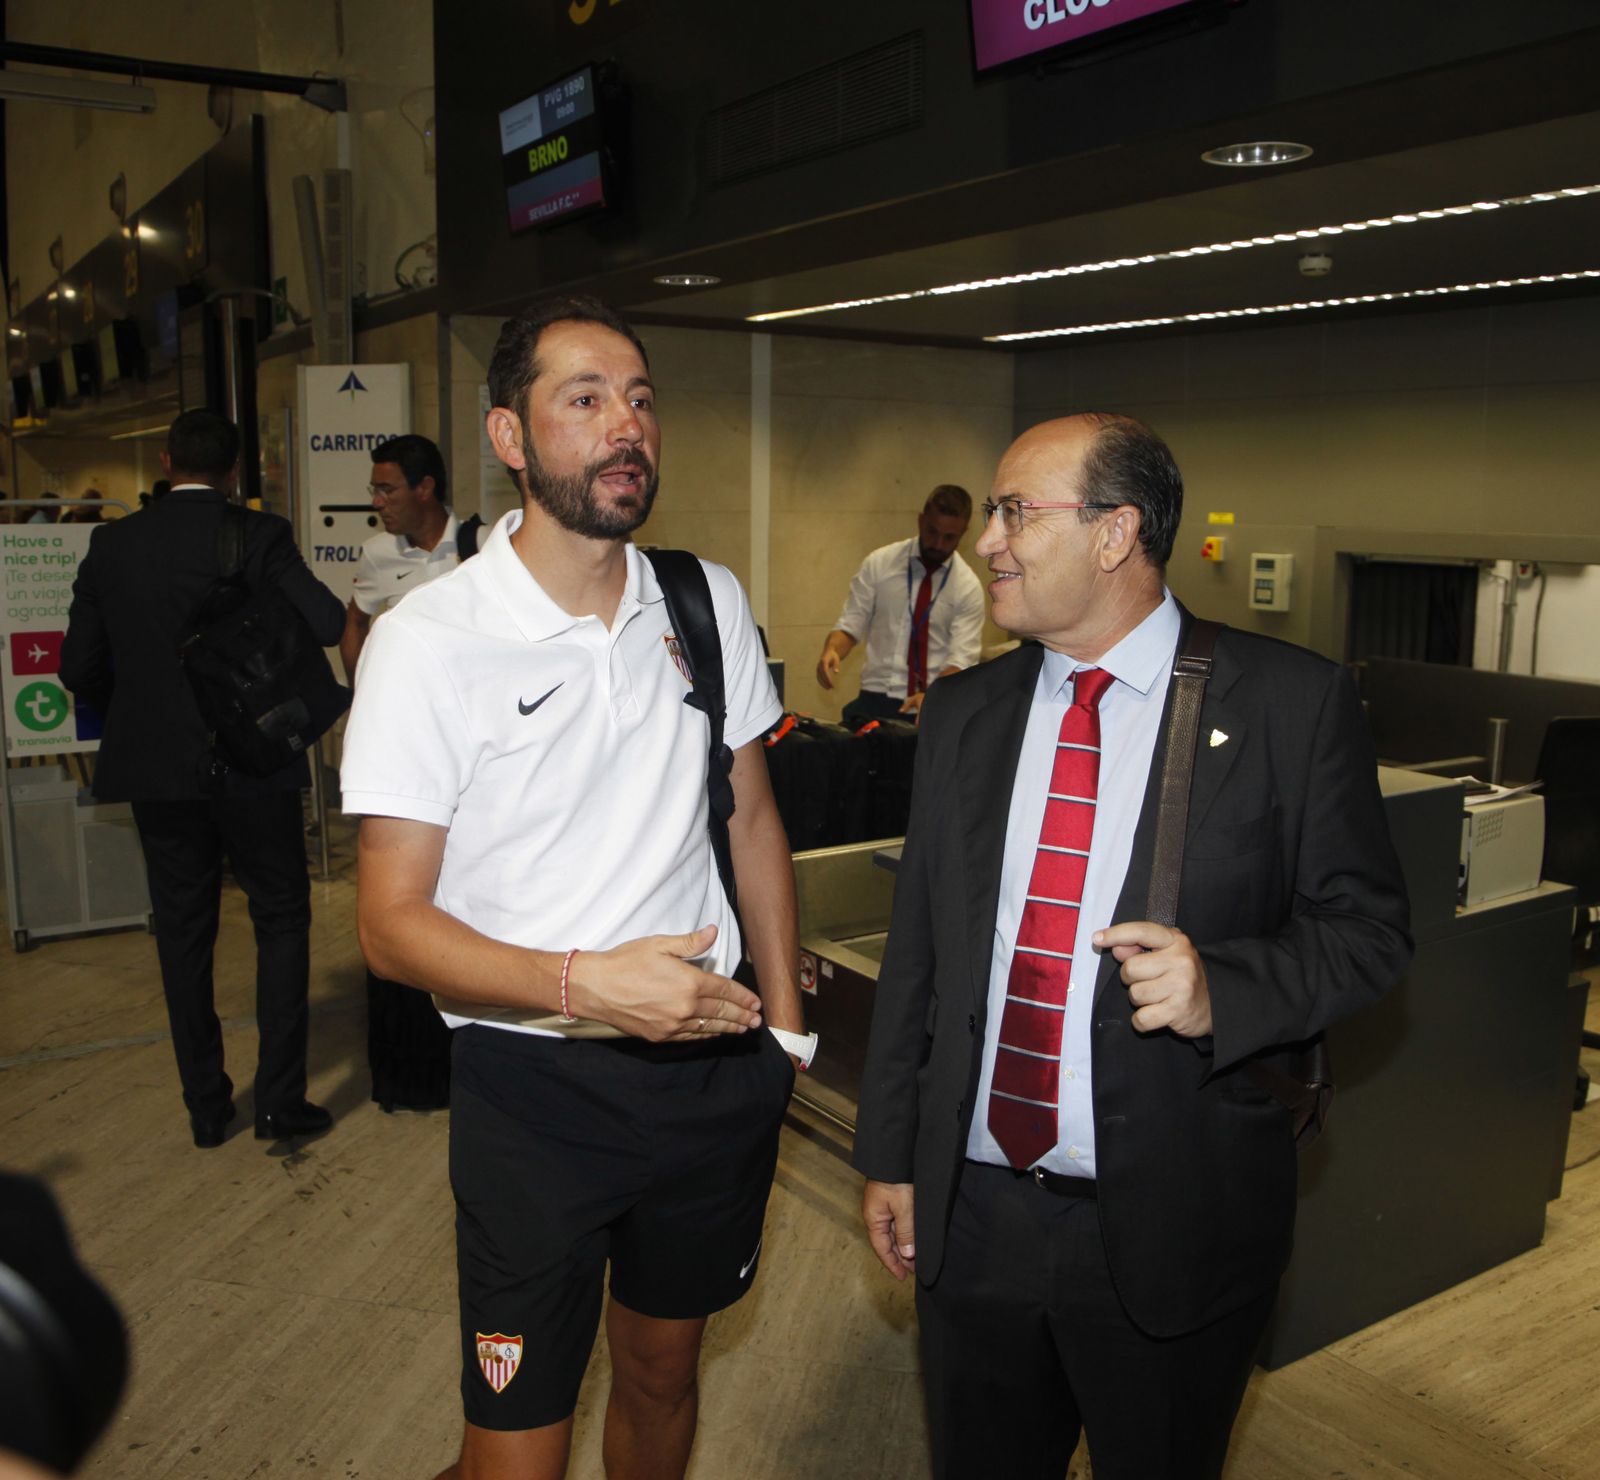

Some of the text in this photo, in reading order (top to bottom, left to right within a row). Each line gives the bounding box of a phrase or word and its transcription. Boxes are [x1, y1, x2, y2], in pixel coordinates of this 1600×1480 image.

[528, 135, 568, 172] BRNO
[528, 199, 558, 221] SEVILLA
[3, 534, 63, 548] Have a
[4, 551, 76, 567] nice trip!
[7, 586, 71, 604] un viaje
[17, 736, 72, 747] transavia
